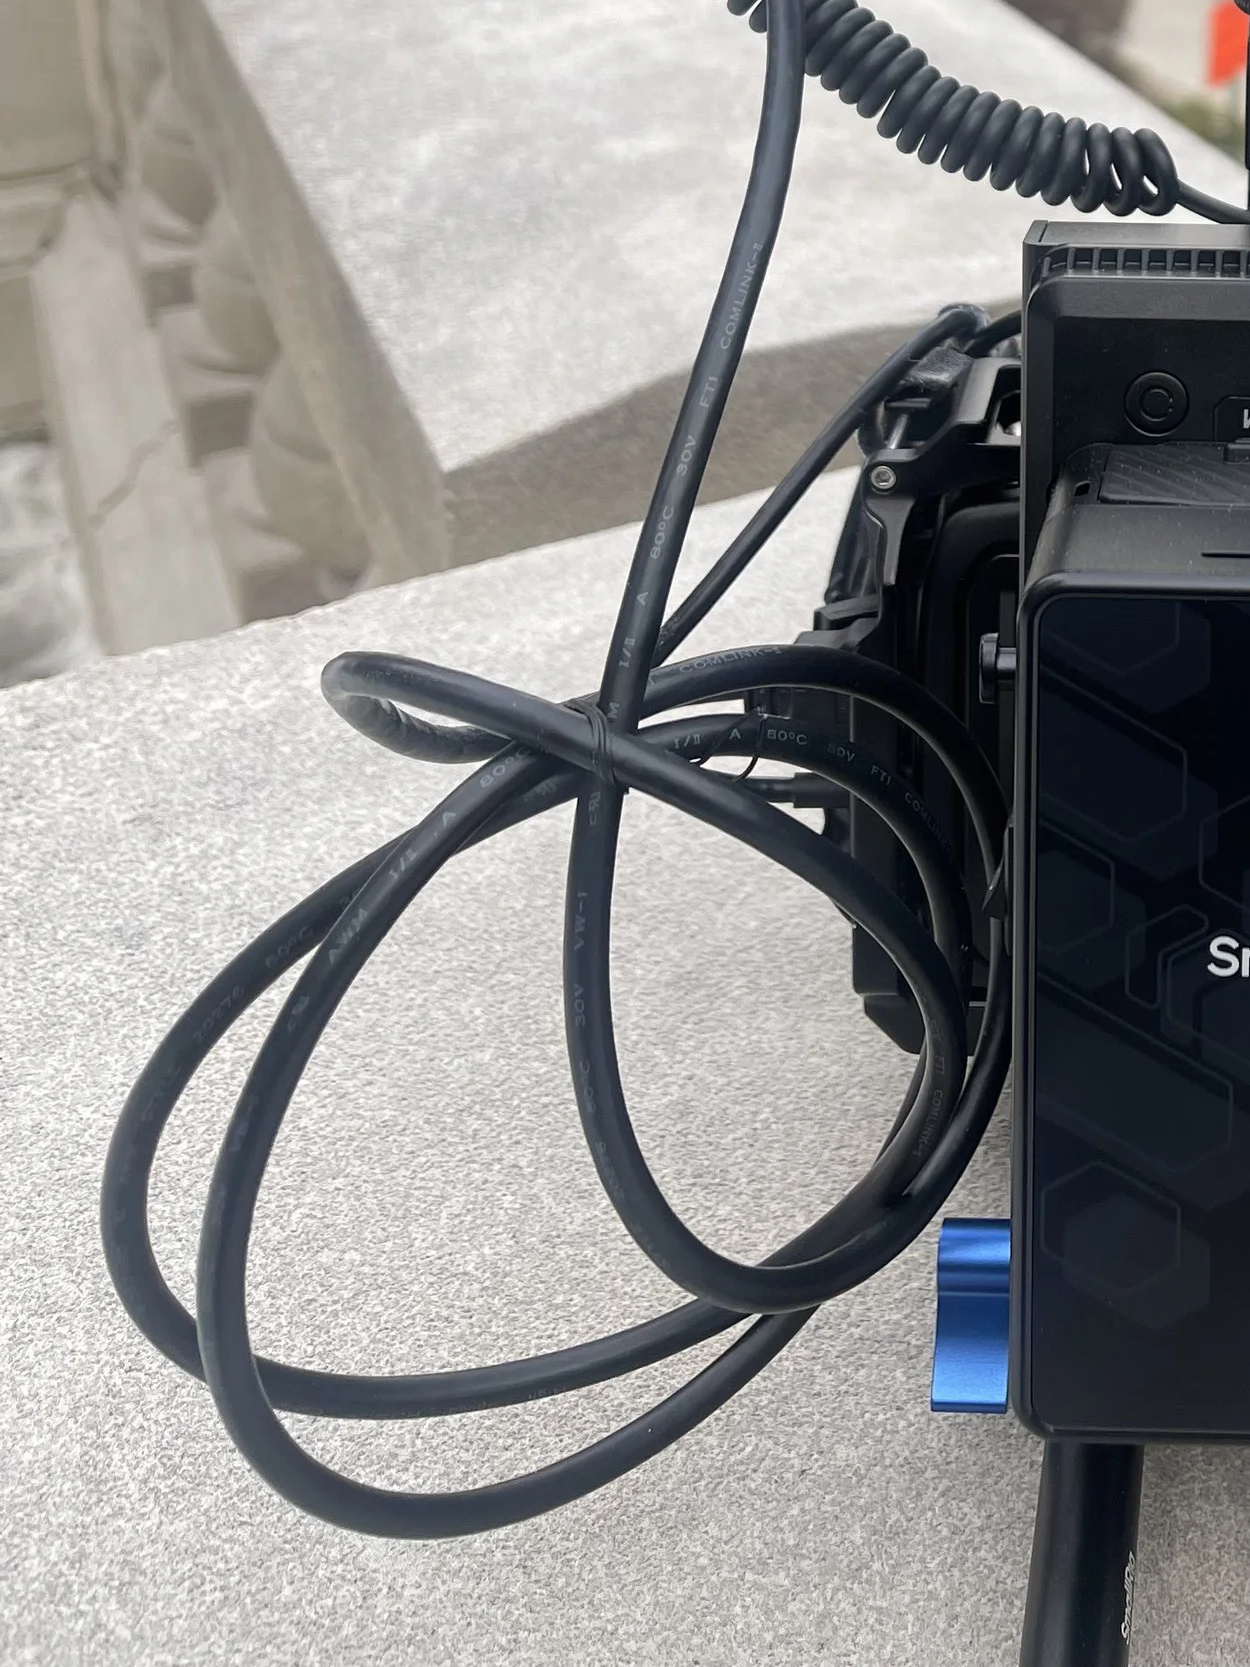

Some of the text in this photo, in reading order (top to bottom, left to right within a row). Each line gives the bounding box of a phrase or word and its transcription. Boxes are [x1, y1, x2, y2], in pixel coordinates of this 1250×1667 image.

[675, 435, 697, 476] 30V
[729, 727, 742, 741] A
[573, 982, 585, 1027] 30V
